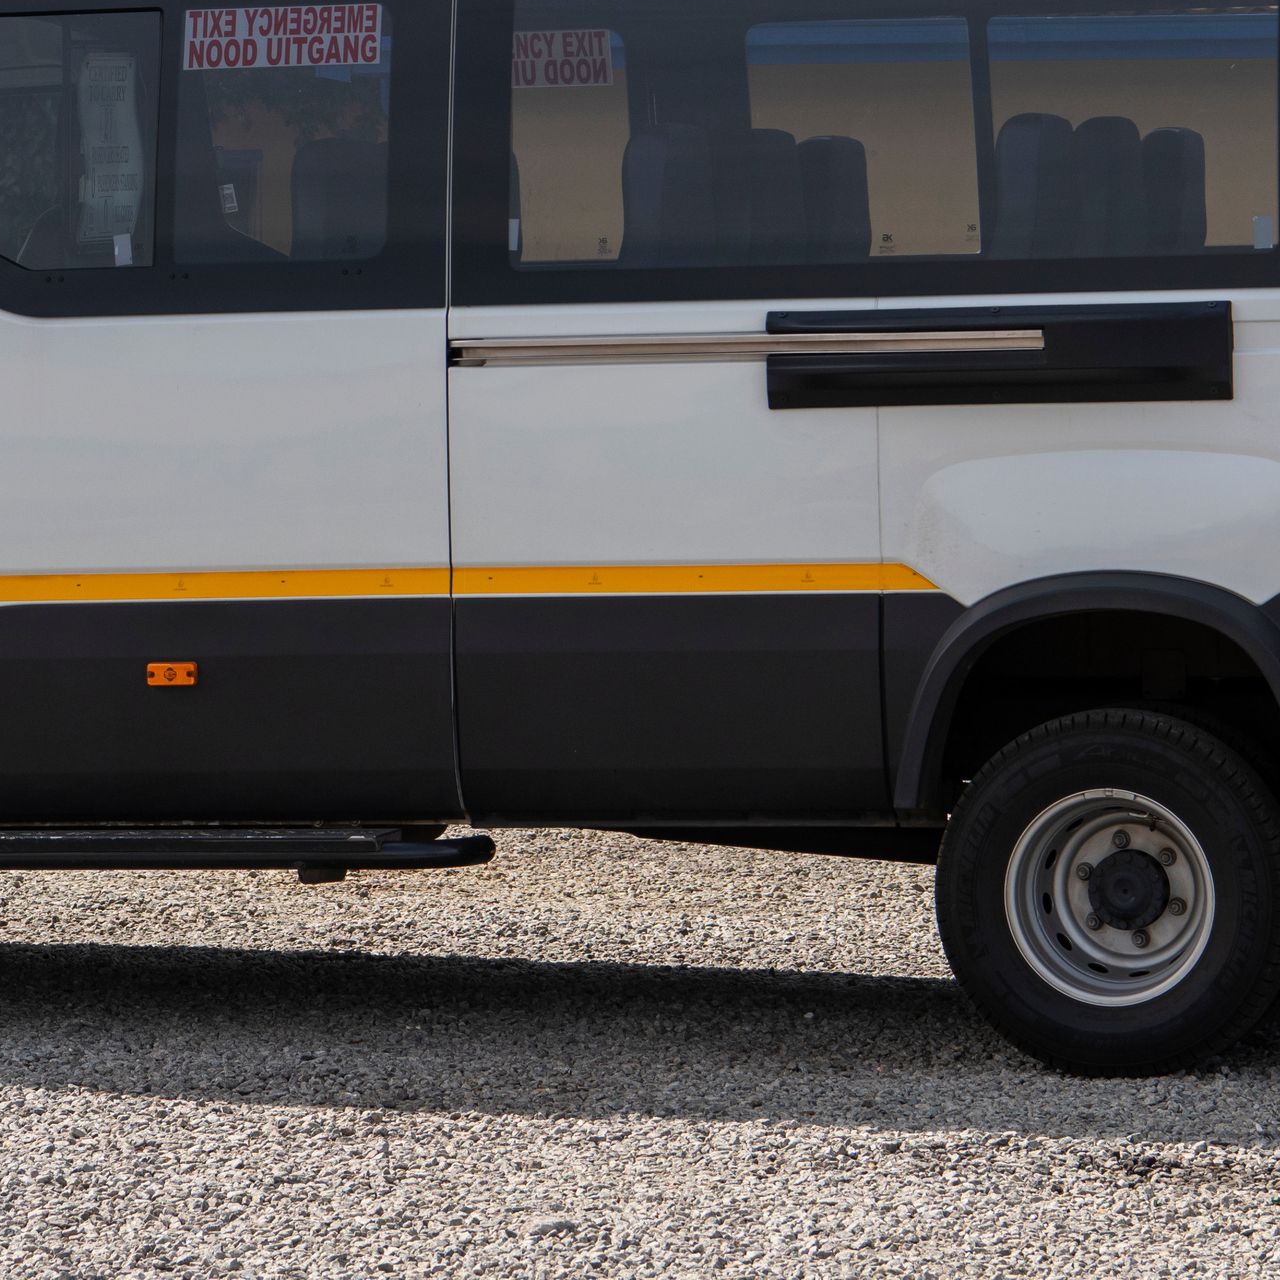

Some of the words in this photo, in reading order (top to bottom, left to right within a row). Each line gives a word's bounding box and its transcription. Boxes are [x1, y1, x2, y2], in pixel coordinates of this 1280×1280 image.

[188, 38, 257, 68] NOOD
[266, 34, 377, 65] UITGANG
[513, 32, 556, 59] NCY
[562, 30, 606, 58] EXIT
